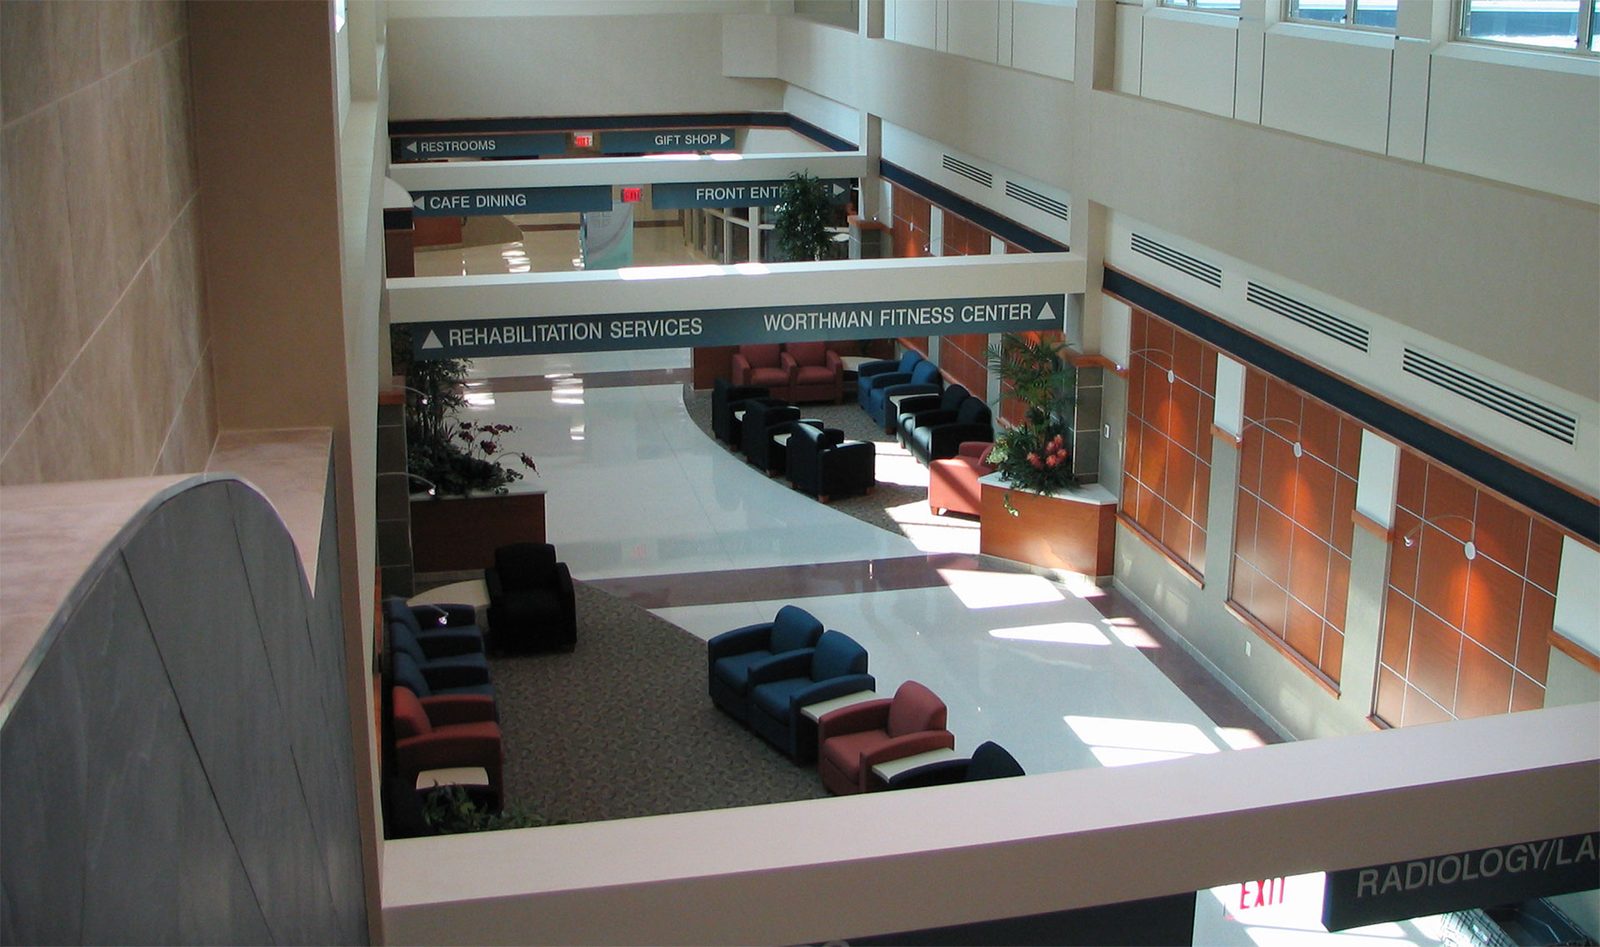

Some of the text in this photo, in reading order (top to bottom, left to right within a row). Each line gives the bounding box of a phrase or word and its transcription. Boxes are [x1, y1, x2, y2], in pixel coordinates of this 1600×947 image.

[421, 140, 496, 152] RESTROOMS
[654, 133, 717, 146] GIFT SHOP
[696, 186, 745, 200] FRONT
[430, 194, 527, 209] CAFE DINING
[763, 303, 1031, 332] WORTHMAN FITNESS CENTER
[449, 317, 703, 347] REHABILITATION SERVICES
[1356, 834, 1600, 898] RADIOLOGY/LA
